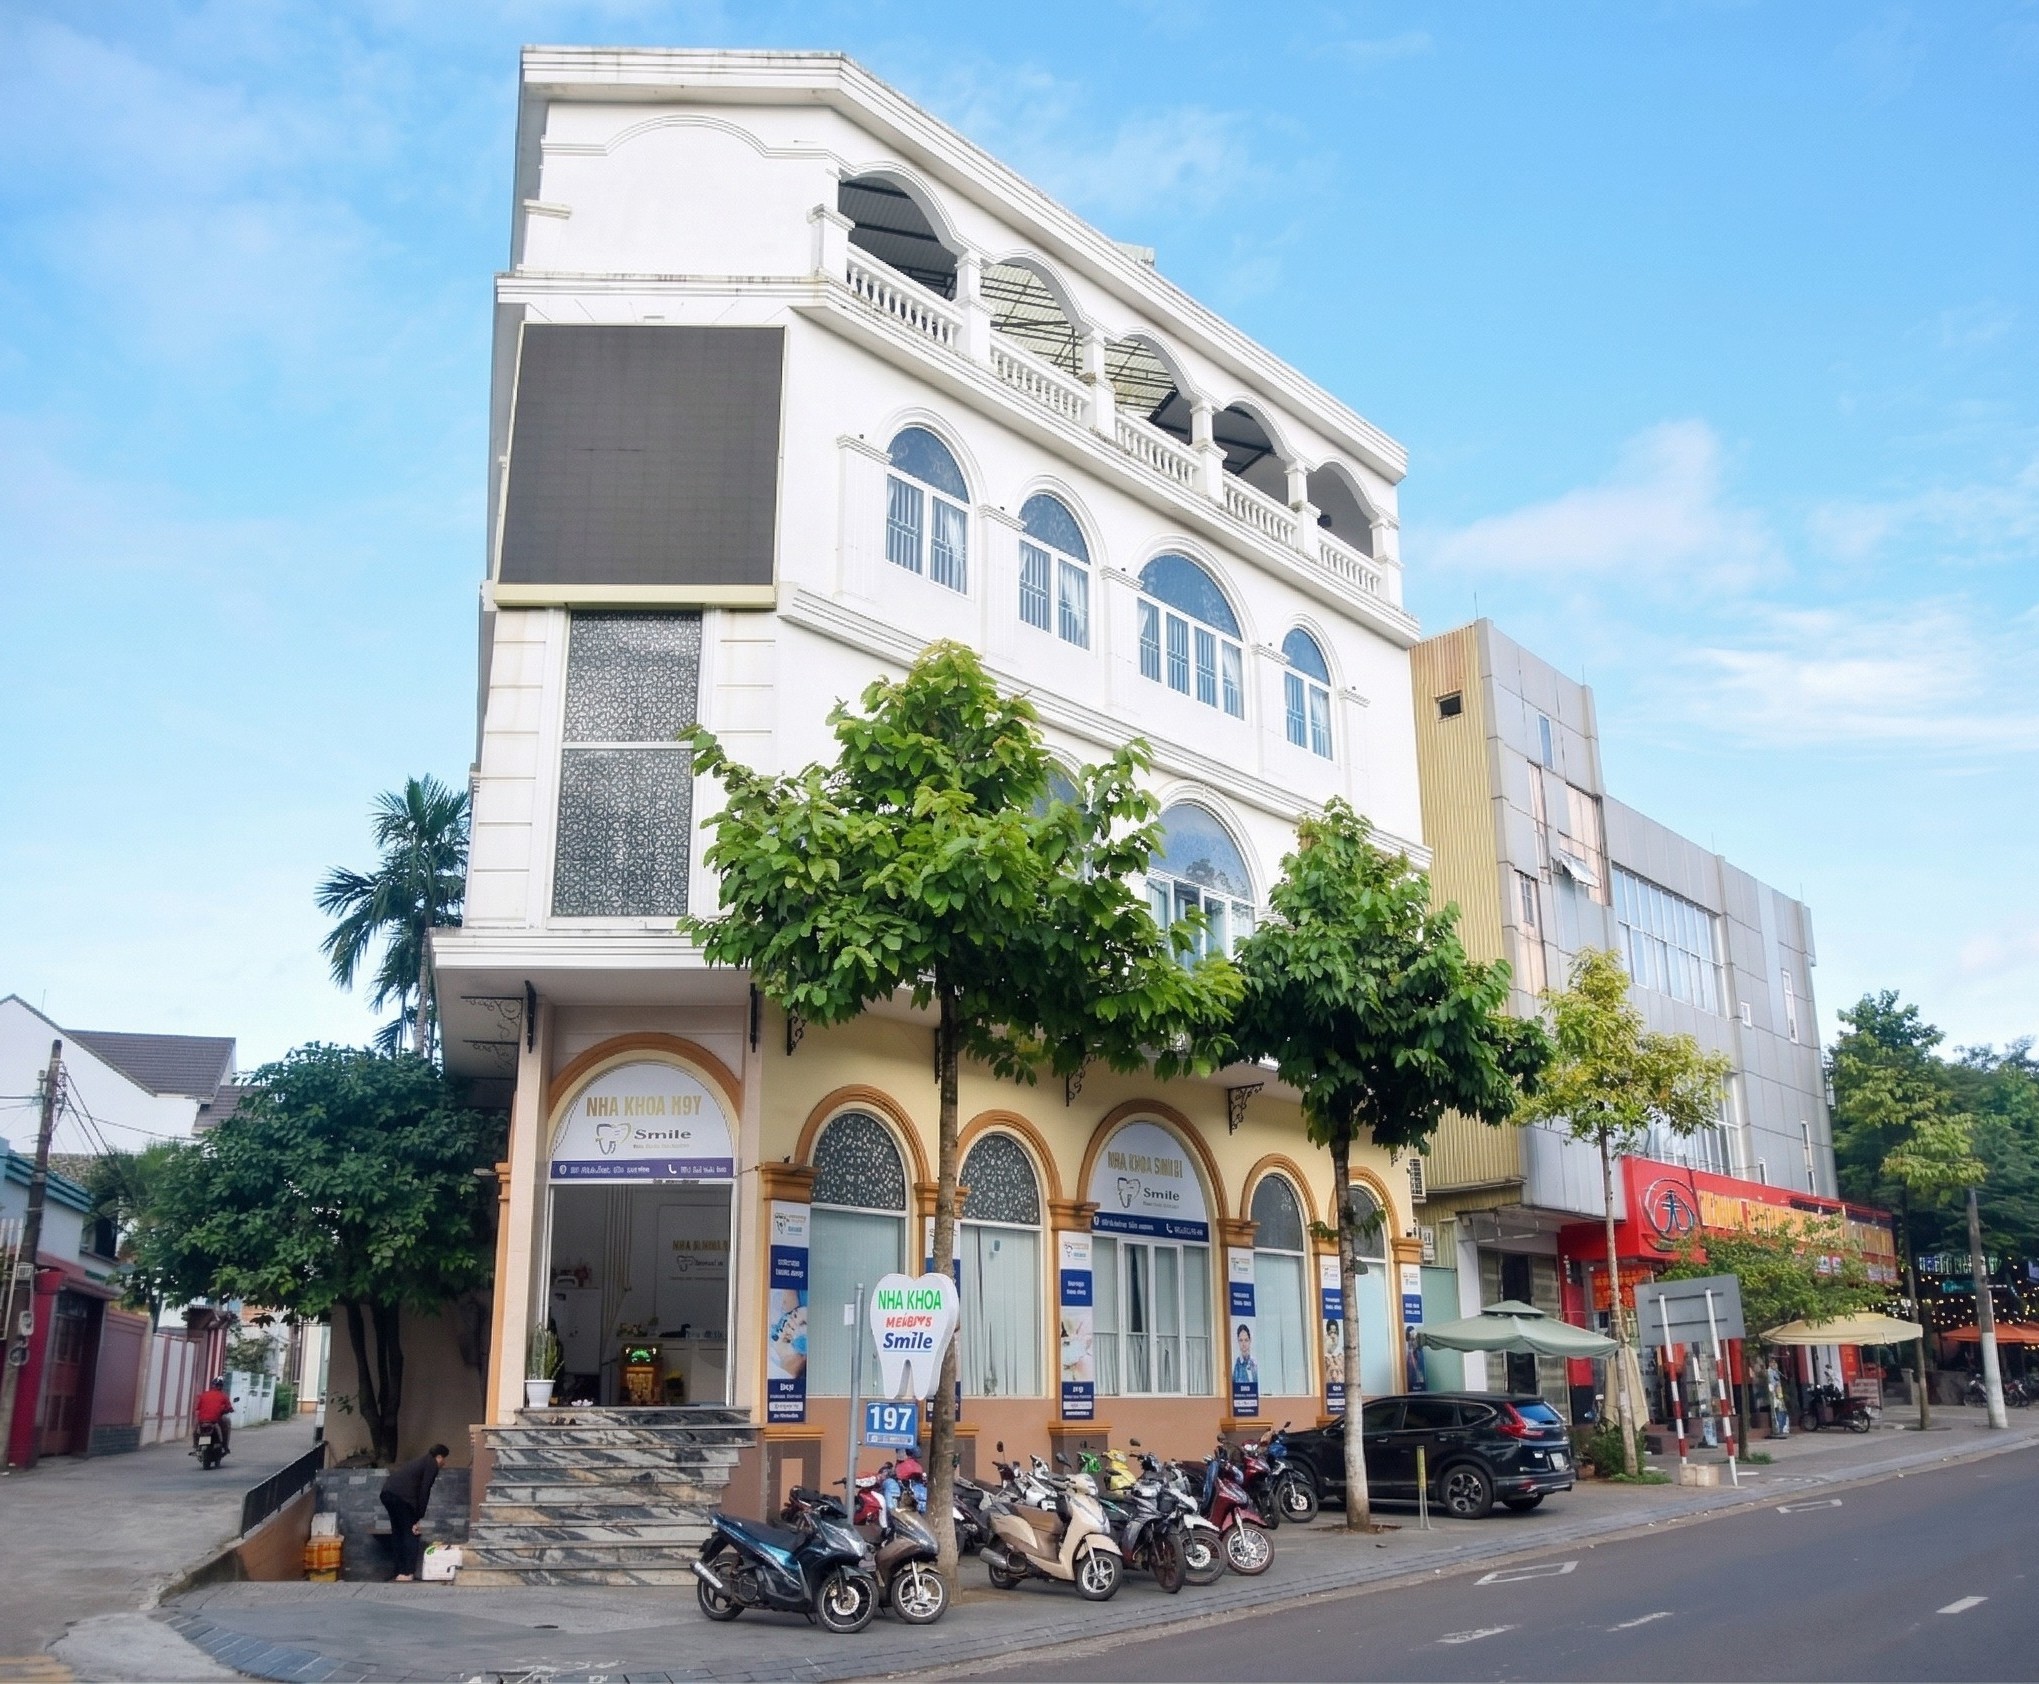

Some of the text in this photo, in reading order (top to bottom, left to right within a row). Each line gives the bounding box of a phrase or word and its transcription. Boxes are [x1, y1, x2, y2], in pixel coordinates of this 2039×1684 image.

[586, 1097, 618, 1117] NHA
[624, 1096, 665, 1116] KHOA
[634, 1129, 692, 1140] Smile
[1143, 1187, 1180, 1201] Smile
[878, 1289, 942, 1310] NHA KHOA
[882, 1331, 933, 1349] Smile
[870, 1406, 912, 1431] 197
